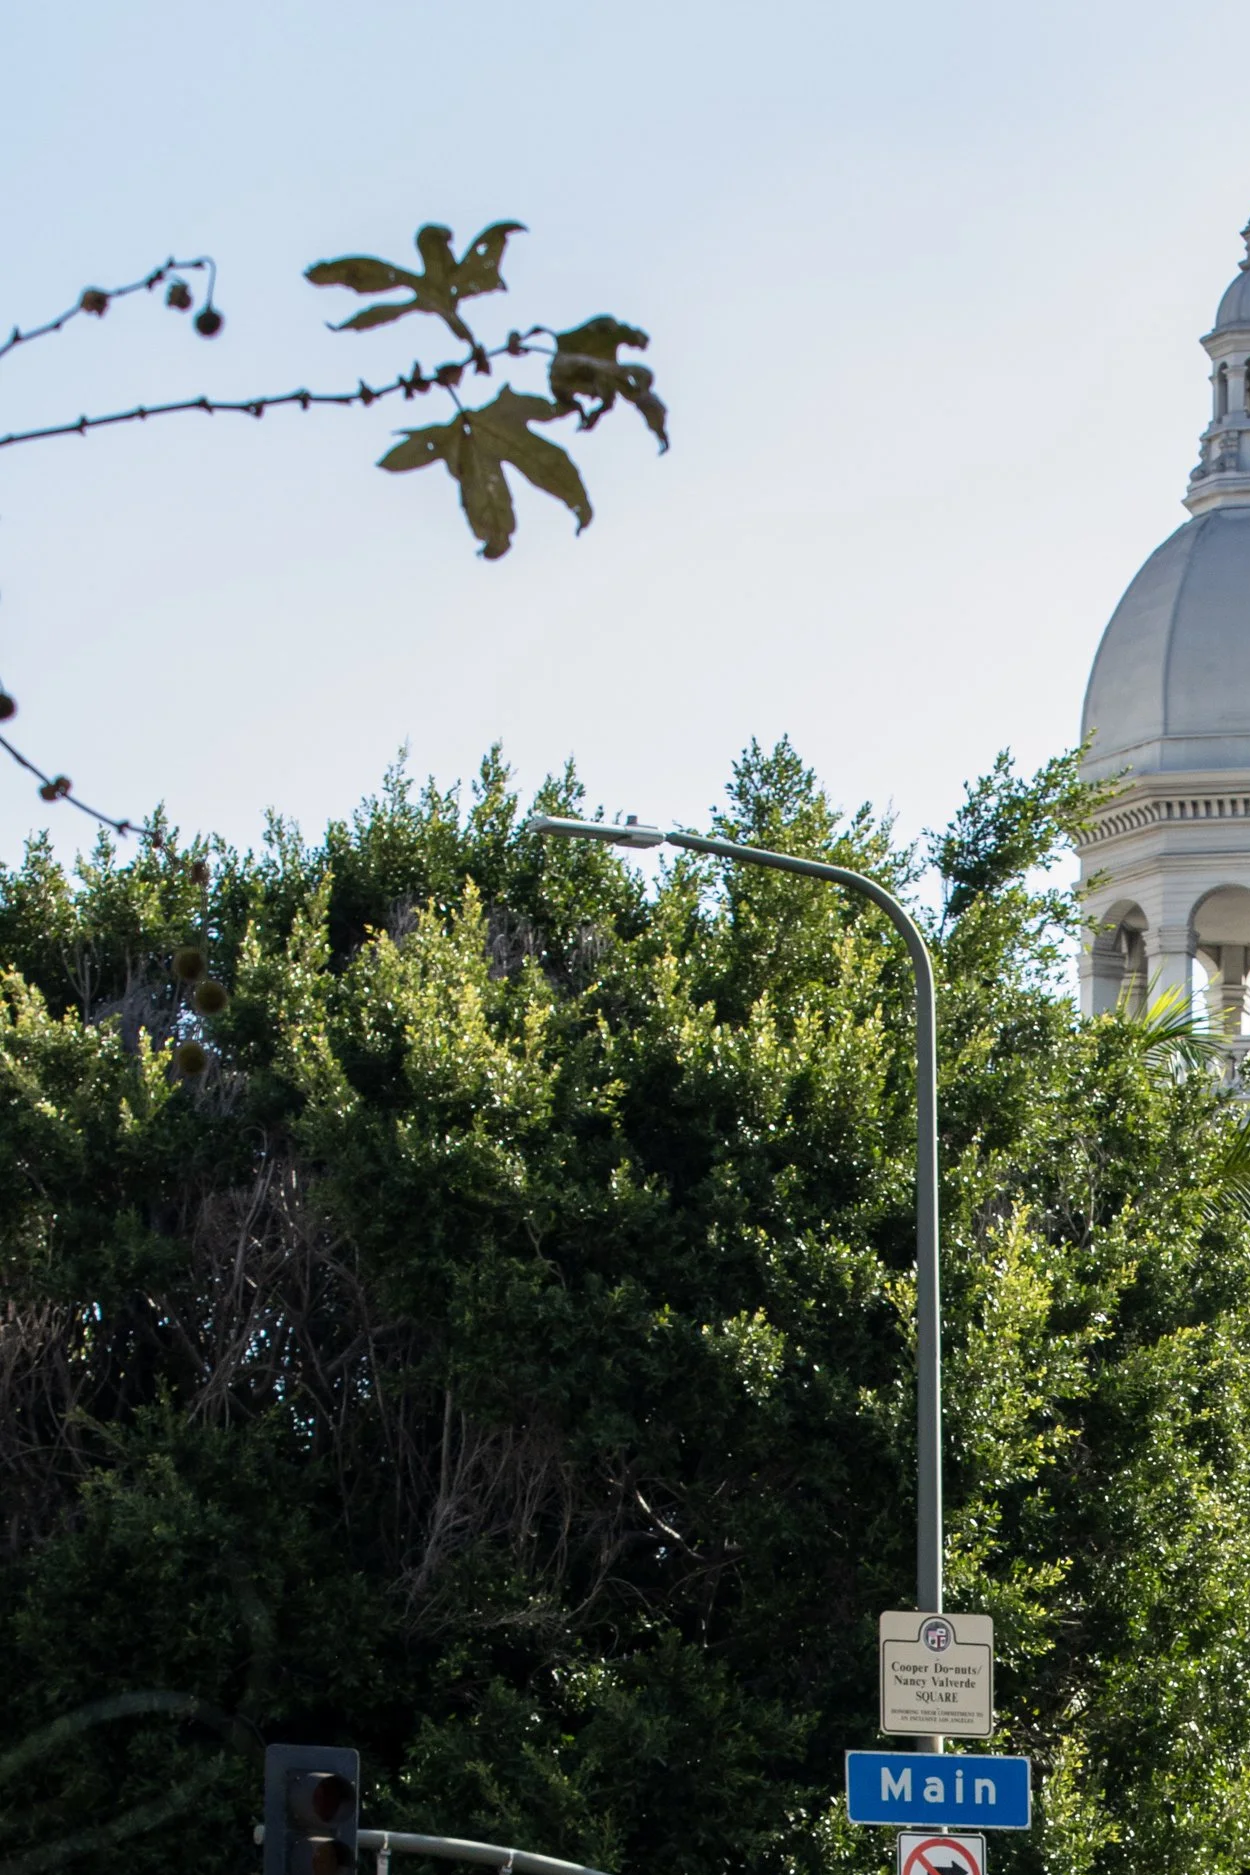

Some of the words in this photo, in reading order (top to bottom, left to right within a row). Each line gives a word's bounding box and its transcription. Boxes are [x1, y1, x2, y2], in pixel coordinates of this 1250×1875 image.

[891, 1661, 929, 1674] Cooper
[934, 1663, 982, 1675] Do-nuts/
[894, 1675, 926, 1688] Nancy
[931, 1677, 976, 1689] Valverde
[916, 1691, 958, 1704] SQUARE
[881, 1767, 996, 1805] Main
